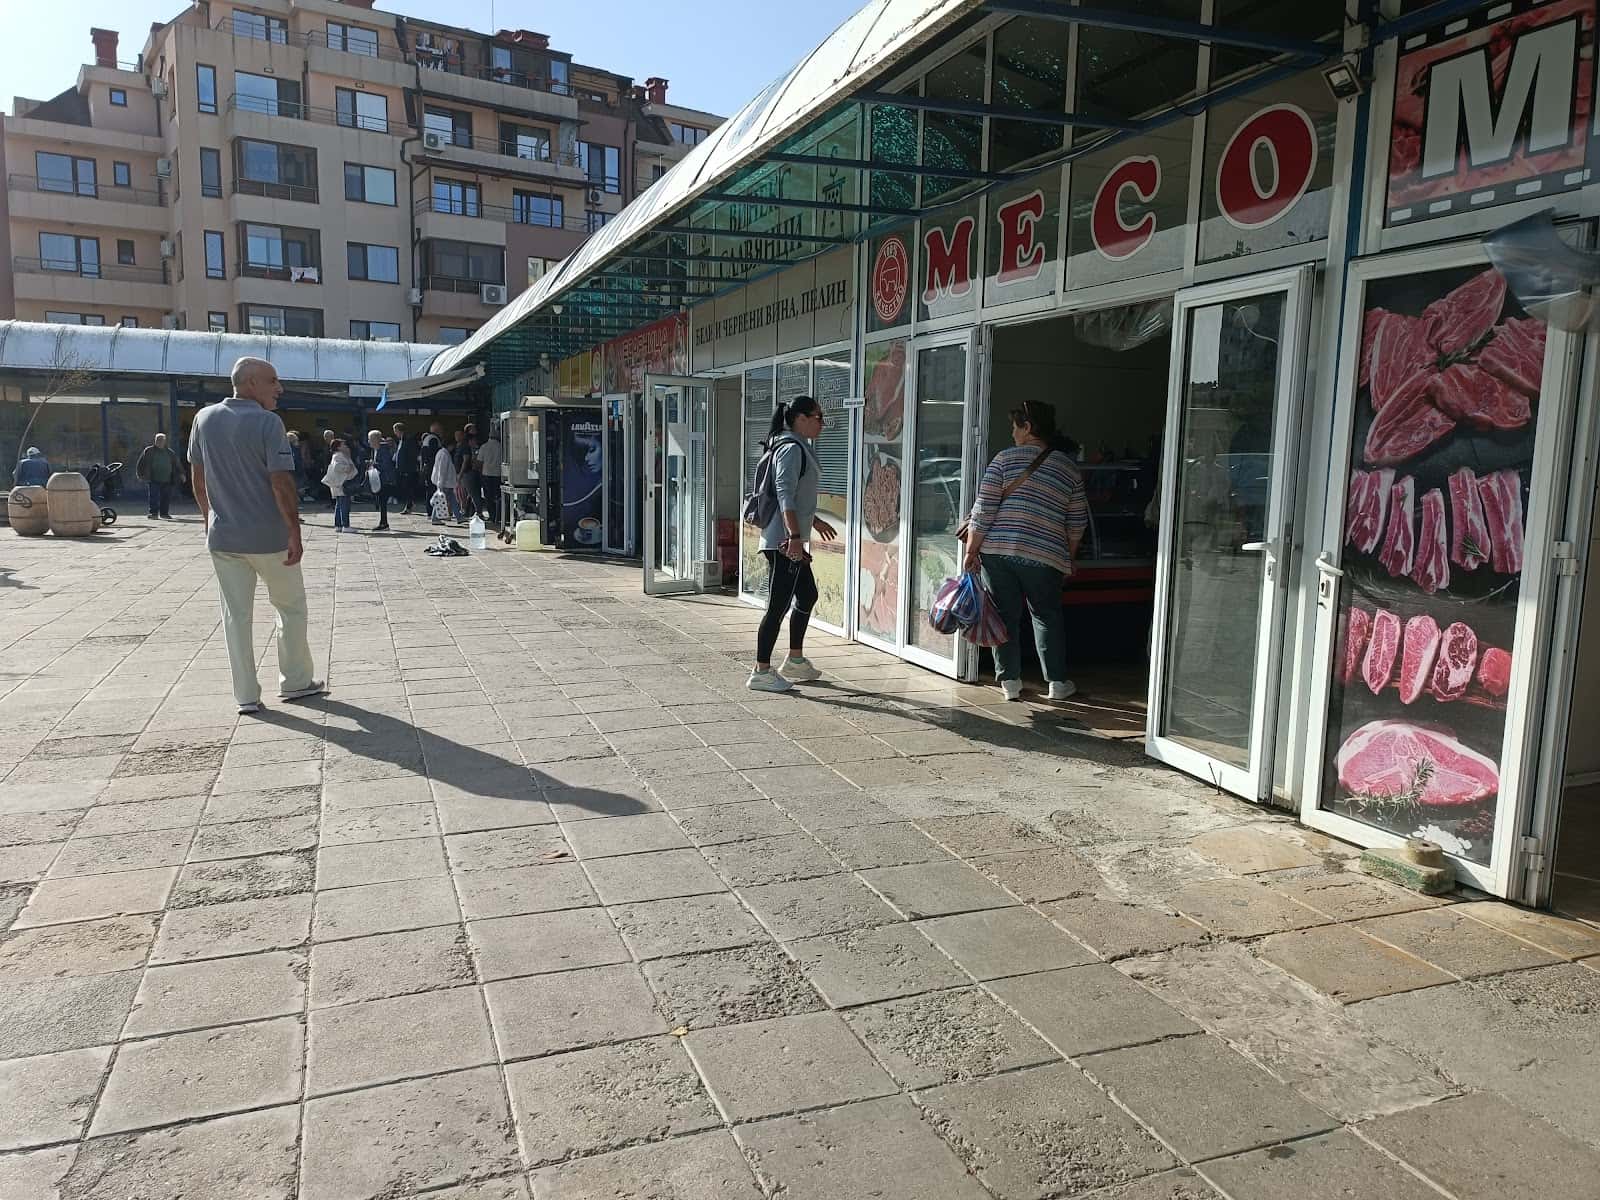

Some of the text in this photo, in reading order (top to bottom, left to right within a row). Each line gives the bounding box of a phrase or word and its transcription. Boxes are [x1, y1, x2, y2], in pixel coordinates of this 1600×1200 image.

[922, 103, 1318, 304] МЕСО
[696, 325, 714, 346] БЕЛИ
[723, 307, 763, 337] ЧЕРВЕНИ
[766, 297, 799, 325] ВИНА,
[801, 280, 846, 314] ПЕЛИН
